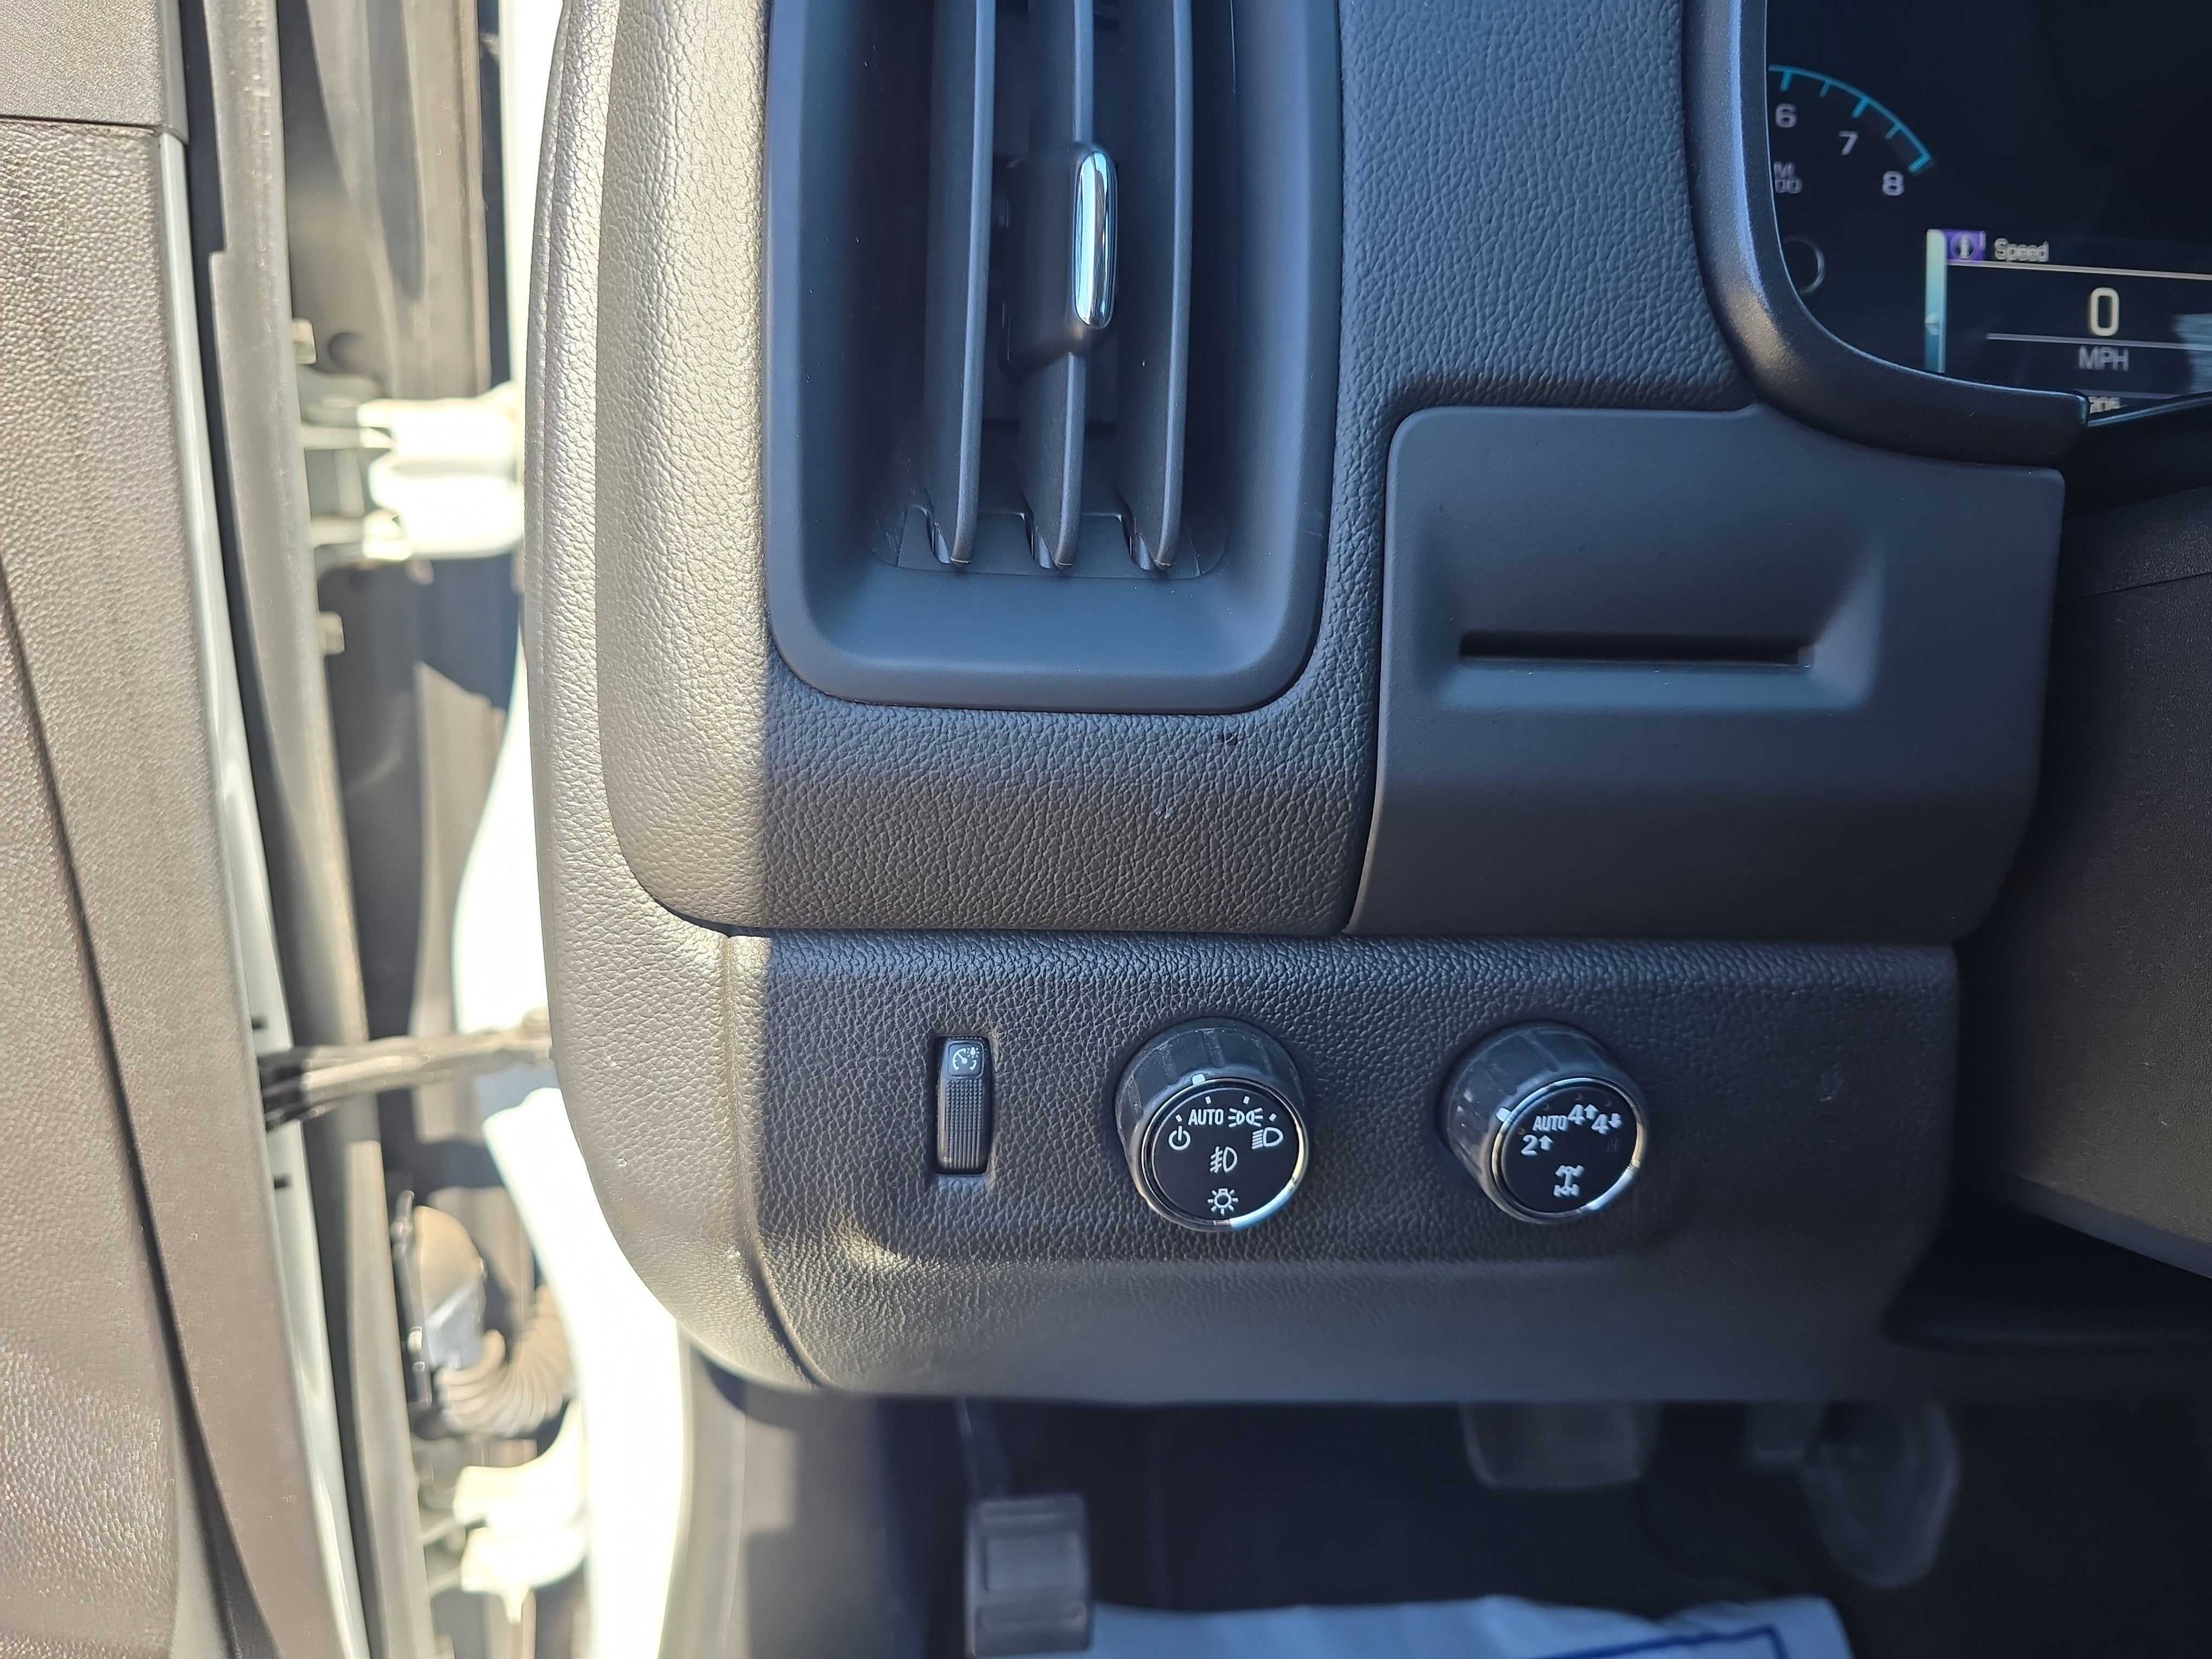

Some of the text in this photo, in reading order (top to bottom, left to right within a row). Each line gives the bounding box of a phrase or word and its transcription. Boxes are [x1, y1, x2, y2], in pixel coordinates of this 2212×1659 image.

[1775, 104, 1797, 128] 6
[1839, 131, 1859, 155] 7
[1882, 171, 1905, 196] 8
[1995, 238, 2049, 262] Speed
[2089, 287, 2120, 336] 0
[2079, 346, 2129, 370] MPH
[1188, 1109, 1224, 1126] AUTO
[1532, 1115, 1568, 1131] AUTO
[1567, 1104, 1584, 1125] 4
[1591, 1114, 1609, 1135] 4
[1521, 1135, 1538, 1156] 2
